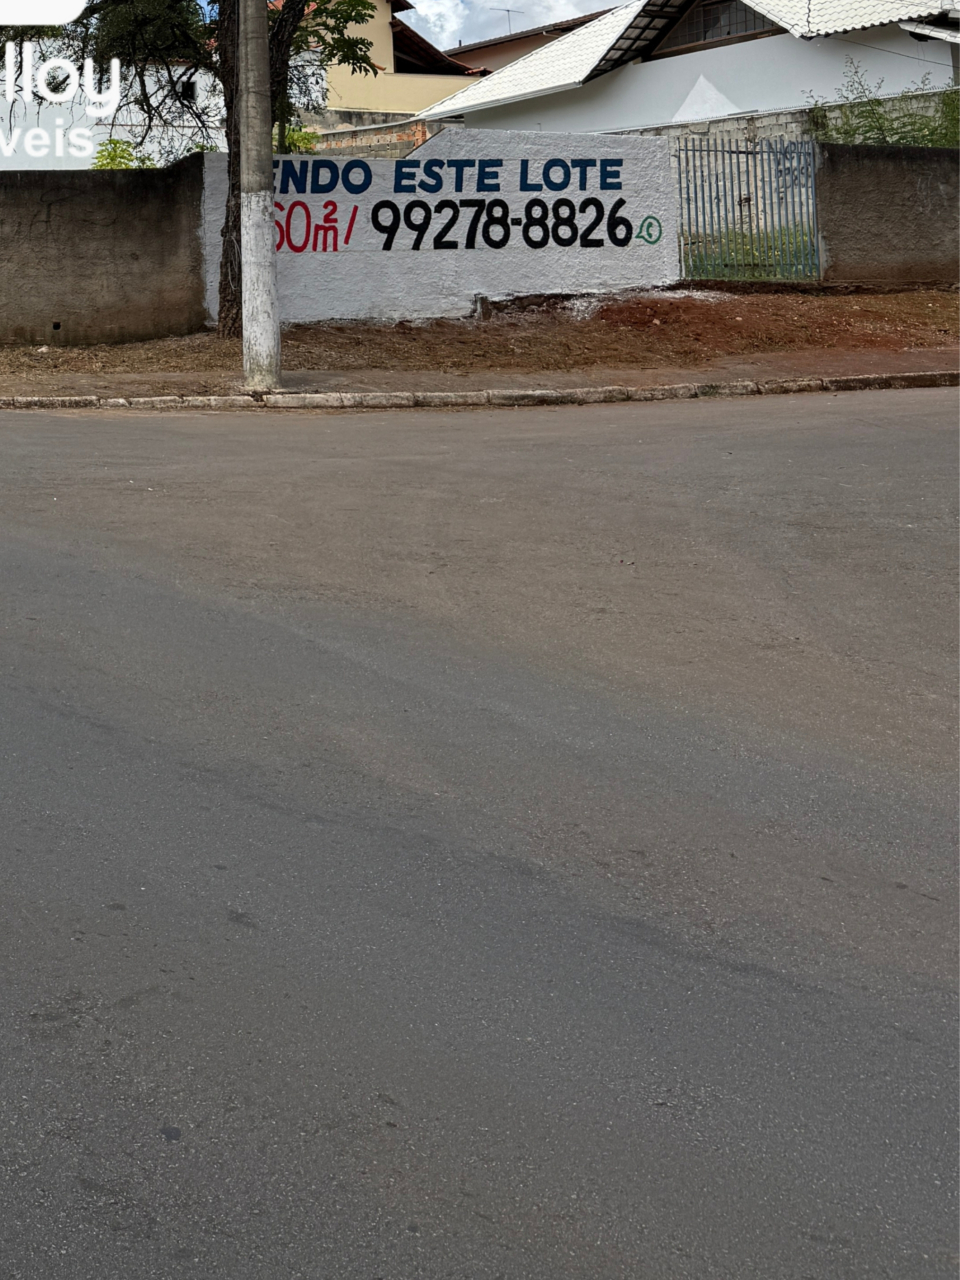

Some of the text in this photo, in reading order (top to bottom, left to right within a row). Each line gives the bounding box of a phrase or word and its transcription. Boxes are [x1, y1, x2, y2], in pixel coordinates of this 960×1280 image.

[393, 158, 503, 194] ESTE
[519, 158, 624, 192] LOTE
[371, 197, 634, 252] 99278-8826
